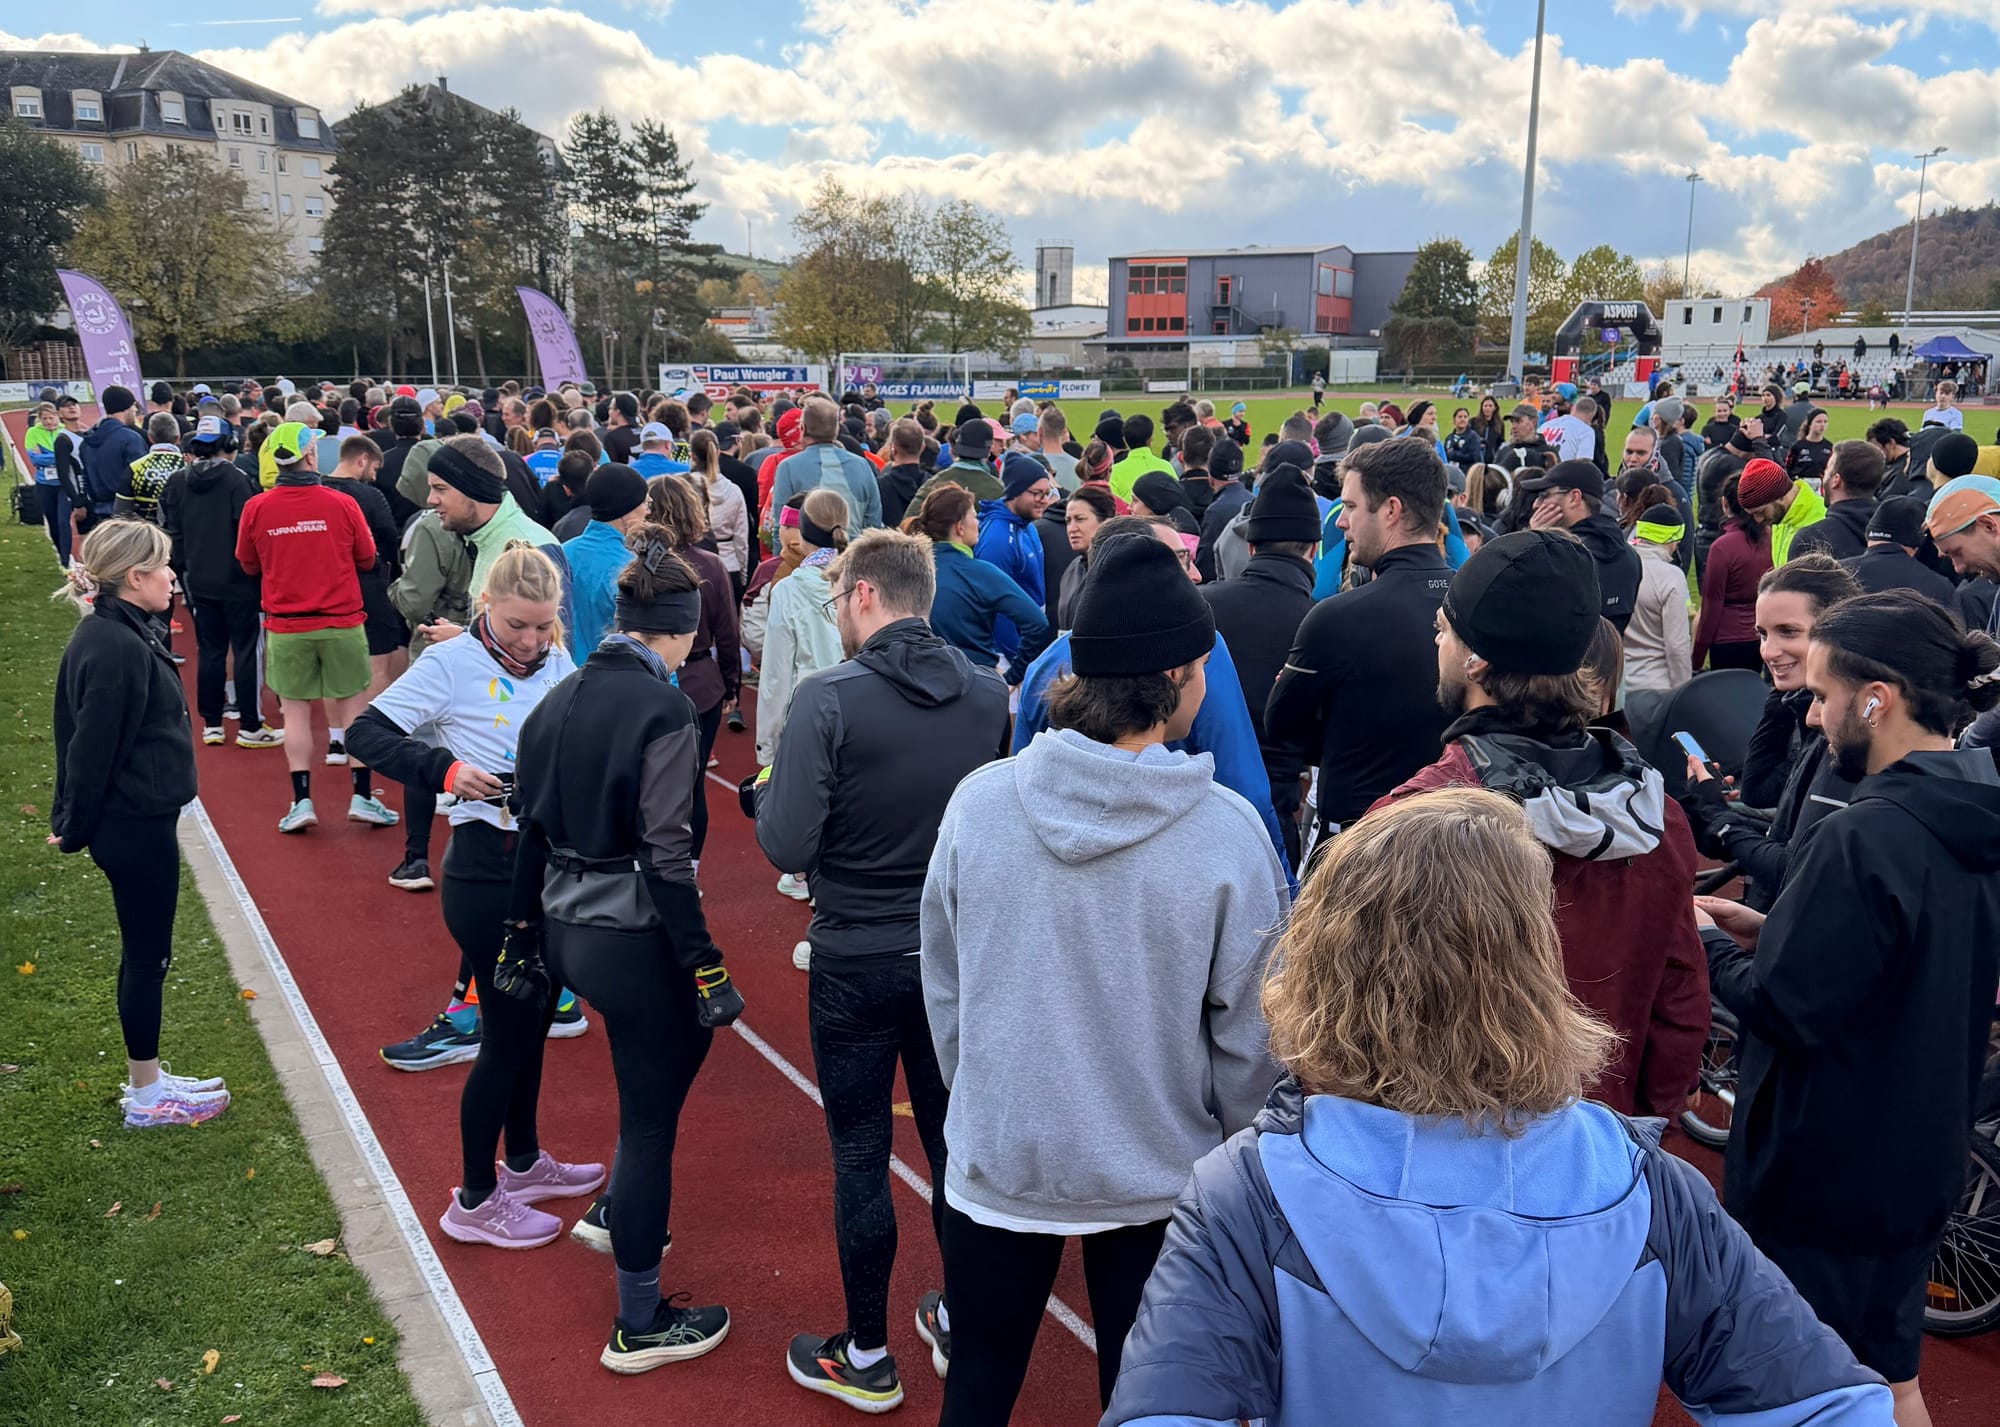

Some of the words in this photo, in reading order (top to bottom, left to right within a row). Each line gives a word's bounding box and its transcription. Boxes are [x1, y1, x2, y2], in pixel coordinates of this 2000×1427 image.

[1603, 304, 1638, 319] ASPORT
[713, 368, 739, 381] Paul
[741, 368, 788, 382] Wengler
[859, 384, 909, 396] VYAGES
[1061, 383, 1092, 392] FLOWEY
[266, 524, 328, 537] TURNVERAIN
[1428, 579, 1449, 589] GORE
